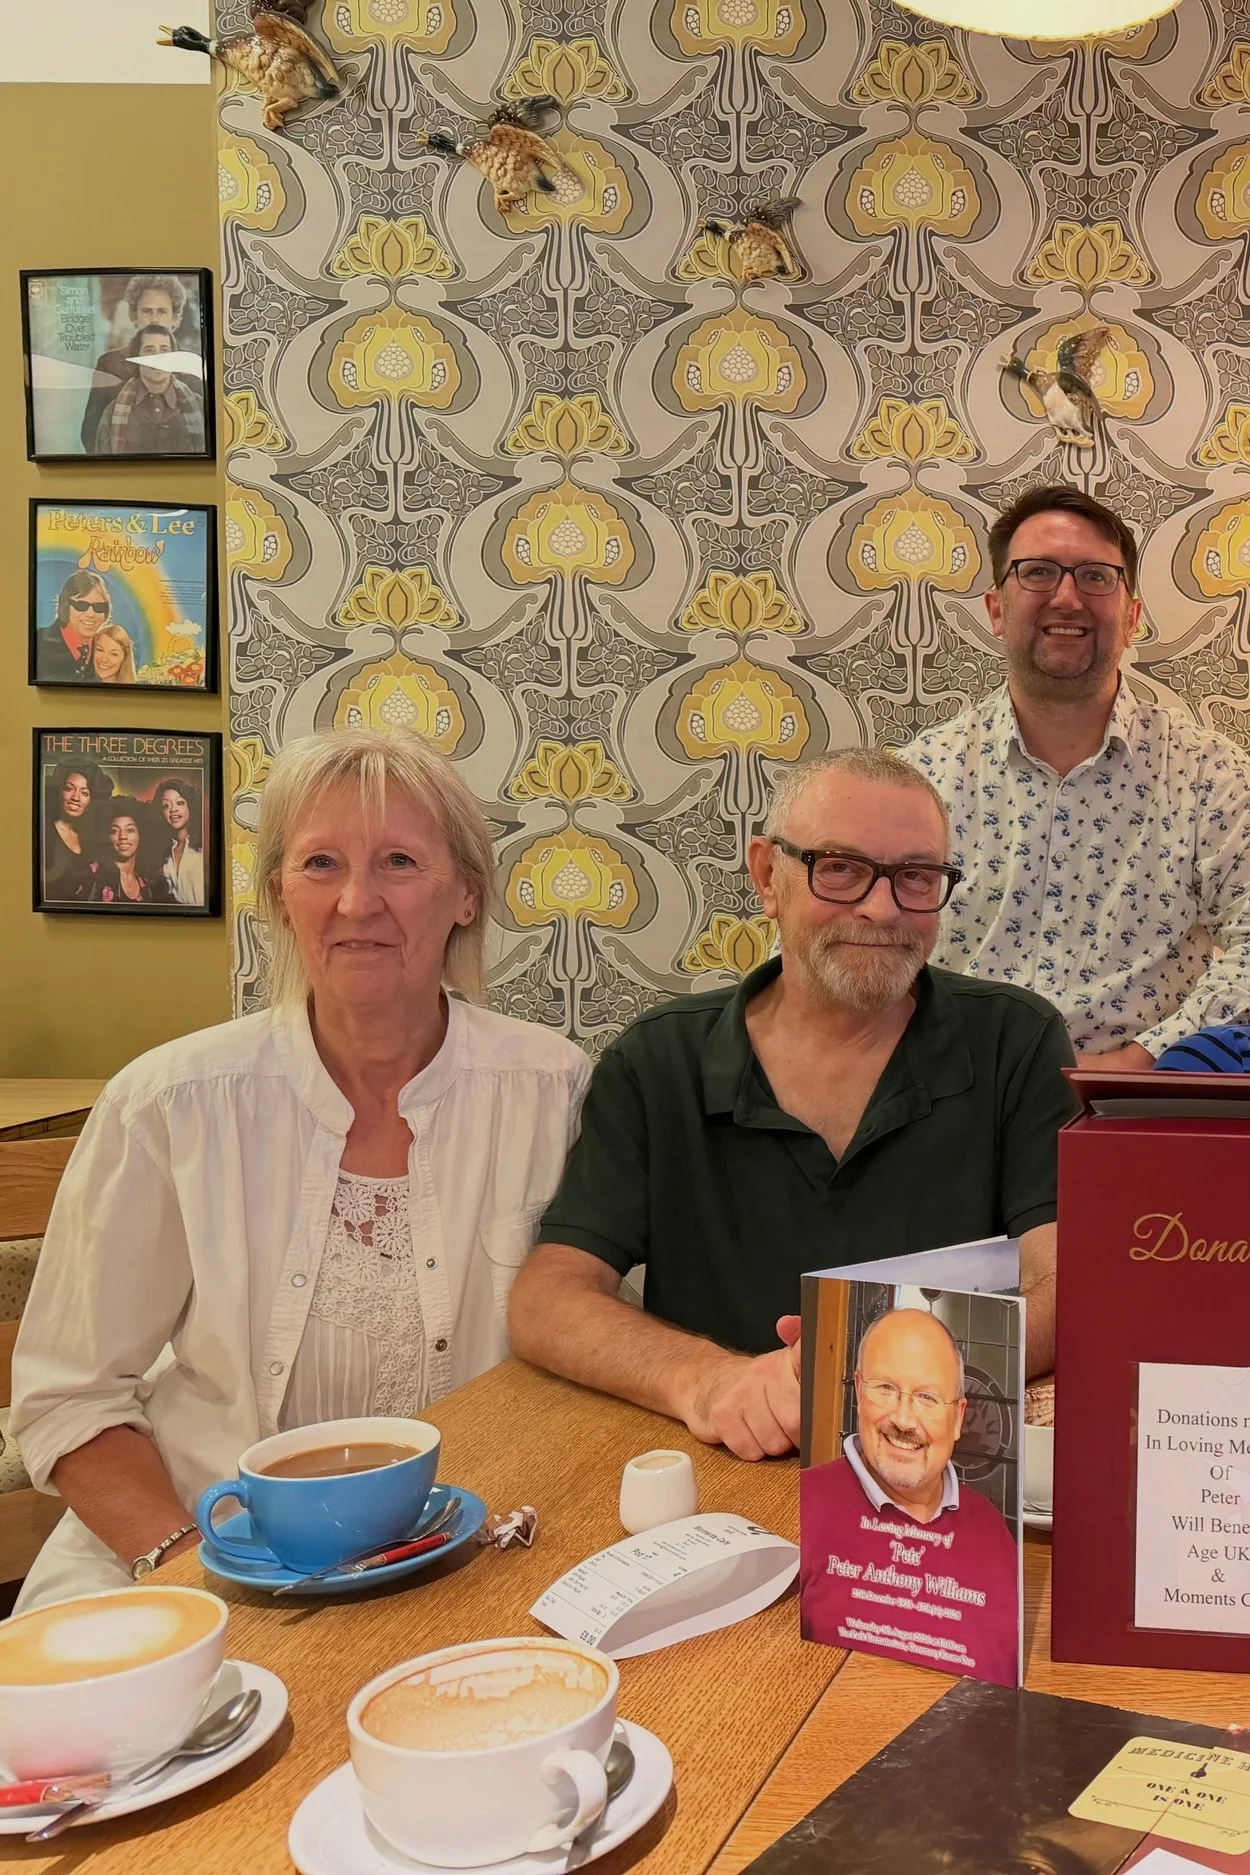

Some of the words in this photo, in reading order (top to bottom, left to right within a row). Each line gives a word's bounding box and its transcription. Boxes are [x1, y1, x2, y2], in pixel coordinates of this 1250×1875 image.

[61, 314, 91, 325] Bridge
[65, 323, 87, 333] Over
[57, 332, 95, 342] Troubled
[64, 343, 90, 352] Water
[49, 510, 123, 532] Peters
[127, 513, 147, 534] &
[151, 512, 196, 535] Lee
[77, 536, 165, 573] Rainbow
[44, 735, 74, 753] THE
[78, 736, 128, 754] THREE
[133, 737, 205, 756] DEGREES
[1157, 1408, 1238, 1428] Donations
[1145, 1434, 1162, 1450] In
[1167, 1436, 1224, 1458] Loving
[1209, 1465, 1234, 1481] Of
[1200, 1489, 1241, 1506] Peter
[860, 1515, 872, 1529] In
[872, 1518, 904, 1539] Loving
[904, 1524, 942, 1547] Memory
[942, 1532, 955, 1549] of
[1171, 1515, 1205, 1533] Will
[1186, 1544, 1219, 1563] Age
[827, 1555, 862, 1578] Peter
[862, 1562, 923, 1596] Anthony
[924, 1572, 987, 1607] Williams
[1210, 1568, 1226, 1583] &
[1163, 1588, 1237, 1607] Moments
[1128, 1745, 1235, 1766] MEDICINE
[1146, 1781, 1175, 1794] ONE
[1180, 1787, 1191, 1796] &
[1196, 1791, 1228, 1804] ONE
[1152, 1794, 1168, 1803] IS
[1173, 1797, 1205, 1811] ONE
